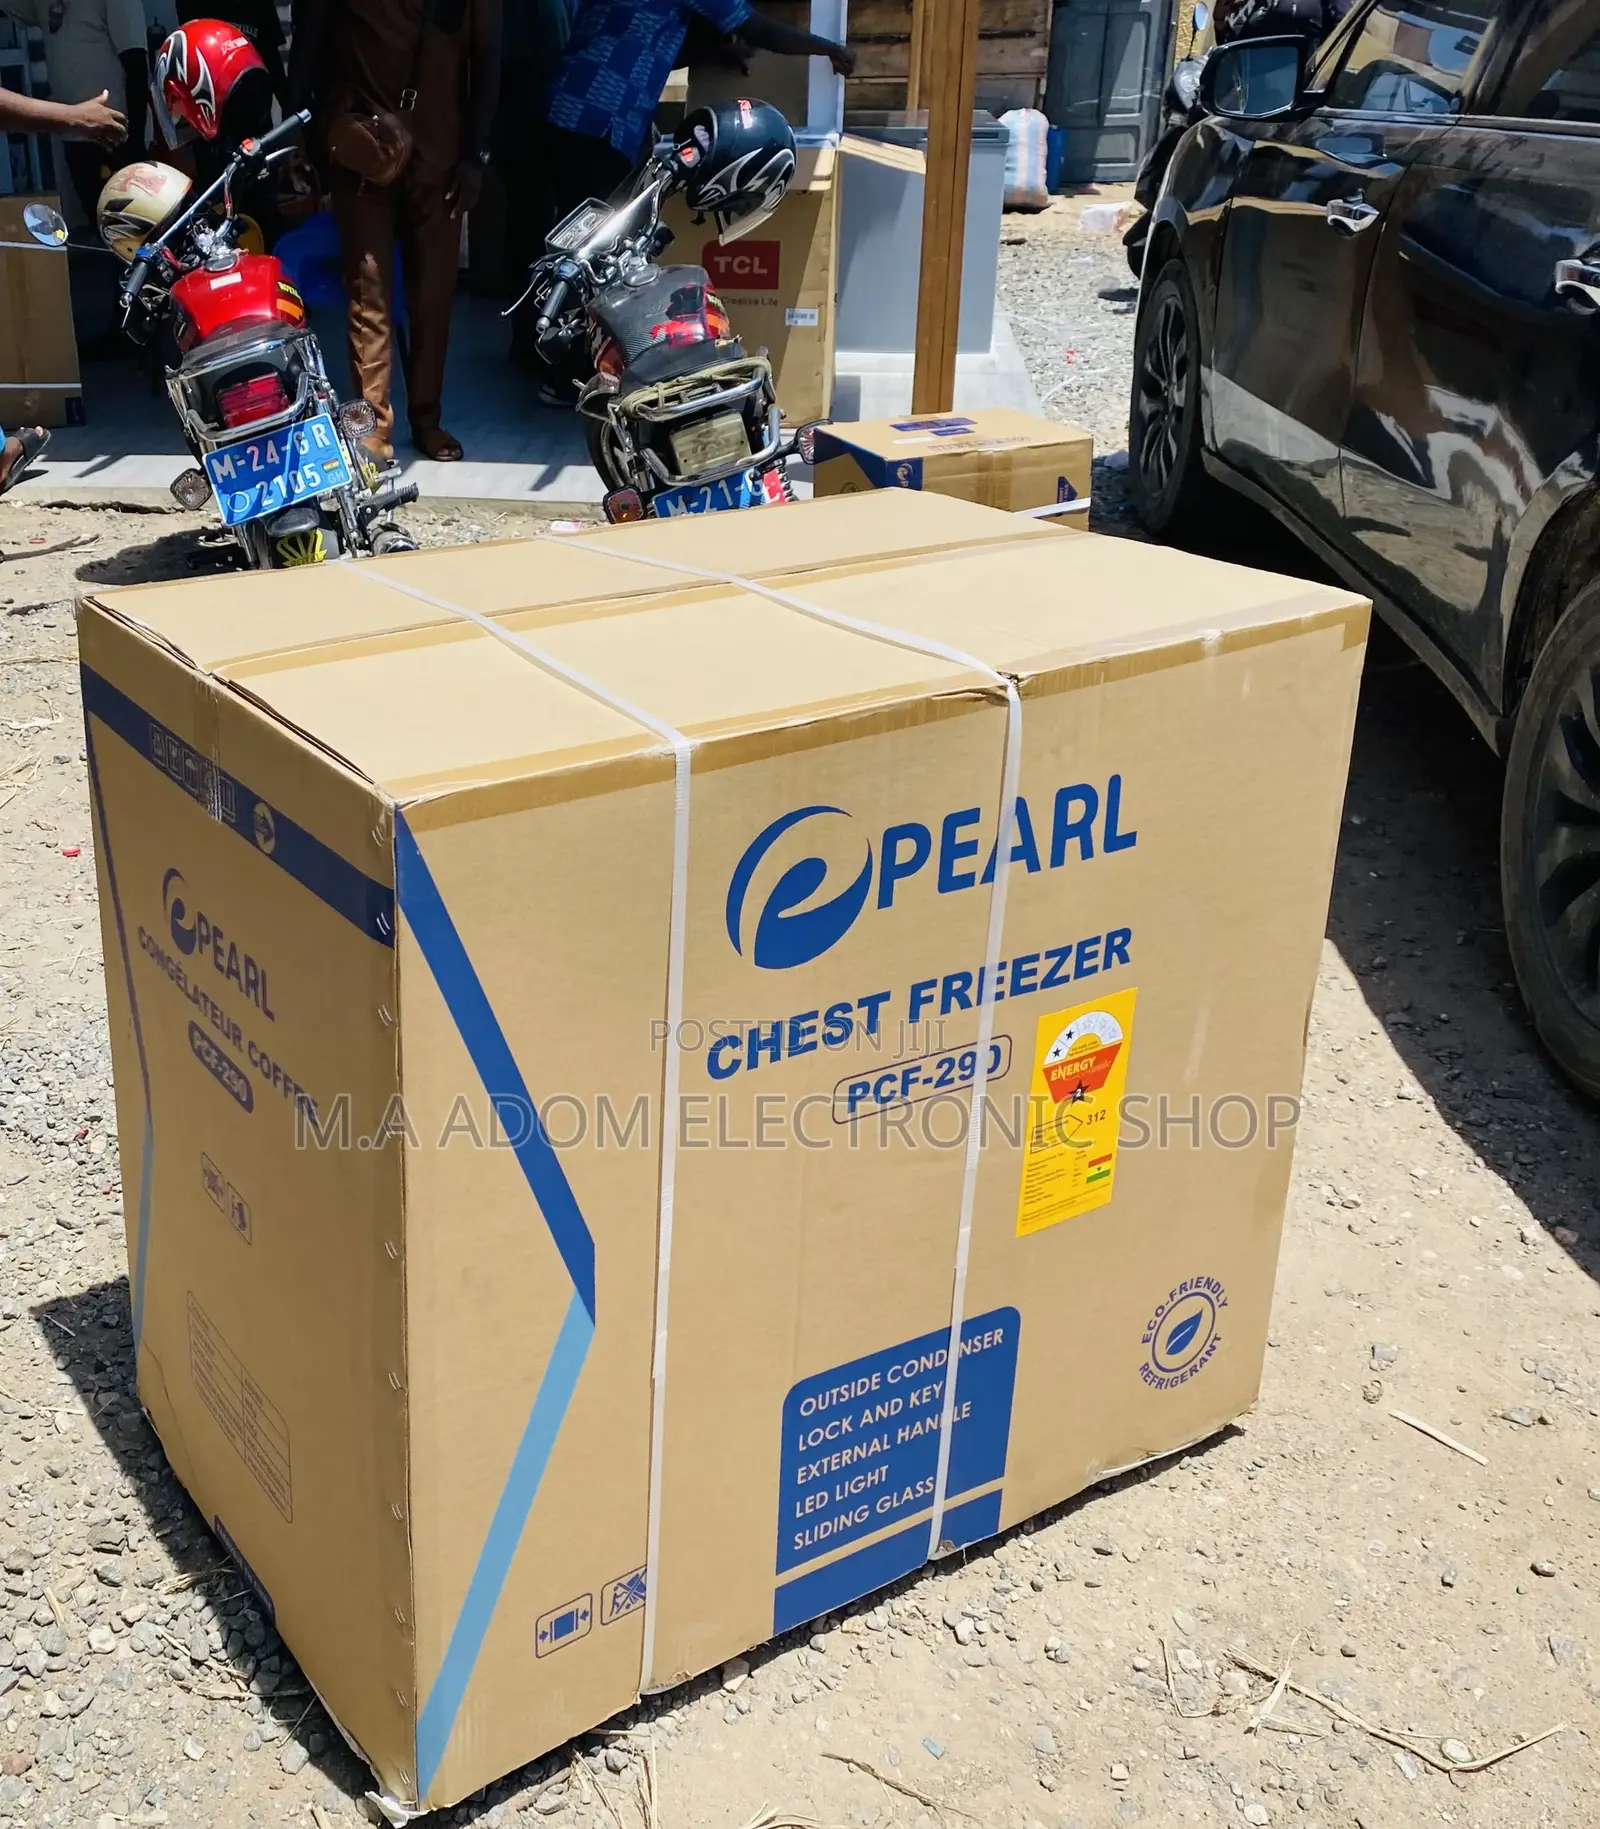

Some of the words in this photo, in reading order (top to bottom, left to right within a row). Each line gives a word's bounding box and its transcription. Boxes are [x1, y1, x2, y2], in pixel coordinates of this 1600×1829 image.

[713, 255, 768, 275] TCL
[210, 422, 332, 485] M-24-GR
[327, 469, 345, 485] GH
[255, 462, 322, 507] 2105
[877, 774, 1138, 910] PEARL
[197, 911, 276, 1023] PEARL
[707, 990, 892, 1081] CHEST
[908, 927, 1133, 1025] FREEZER
[847, 1044, 1001, 1114] PCF-290
[1050, 1056, 1097, 1082] ENERGY
[1075, 1088, 1082, 1097] 2
[1086, 1109, 1106, 1125] 312
[1141, 1276, 1229, 1344] ECO-FRIENDLY
[800, 1372, 882, 1417] OUTSIDE
[887, 1328, 1004, 1384] CONDNSER
[1139, 1333, 1222, 1390] REFRIGERANT
[798, 1415, 854, 1452] LOCK
[859, 1398, 904, 1429] AND
[909, 1380, 944, 1409] KEY
[797, 1433, 892, 1485] EXTERNAL
[793, 1504, 870, 1550] SLIDING
[875, 1476, 935, 1514] GLASS
[795, 1490, 829, 1519] LED
[835, 1465, 889, 1501] LIGHT
